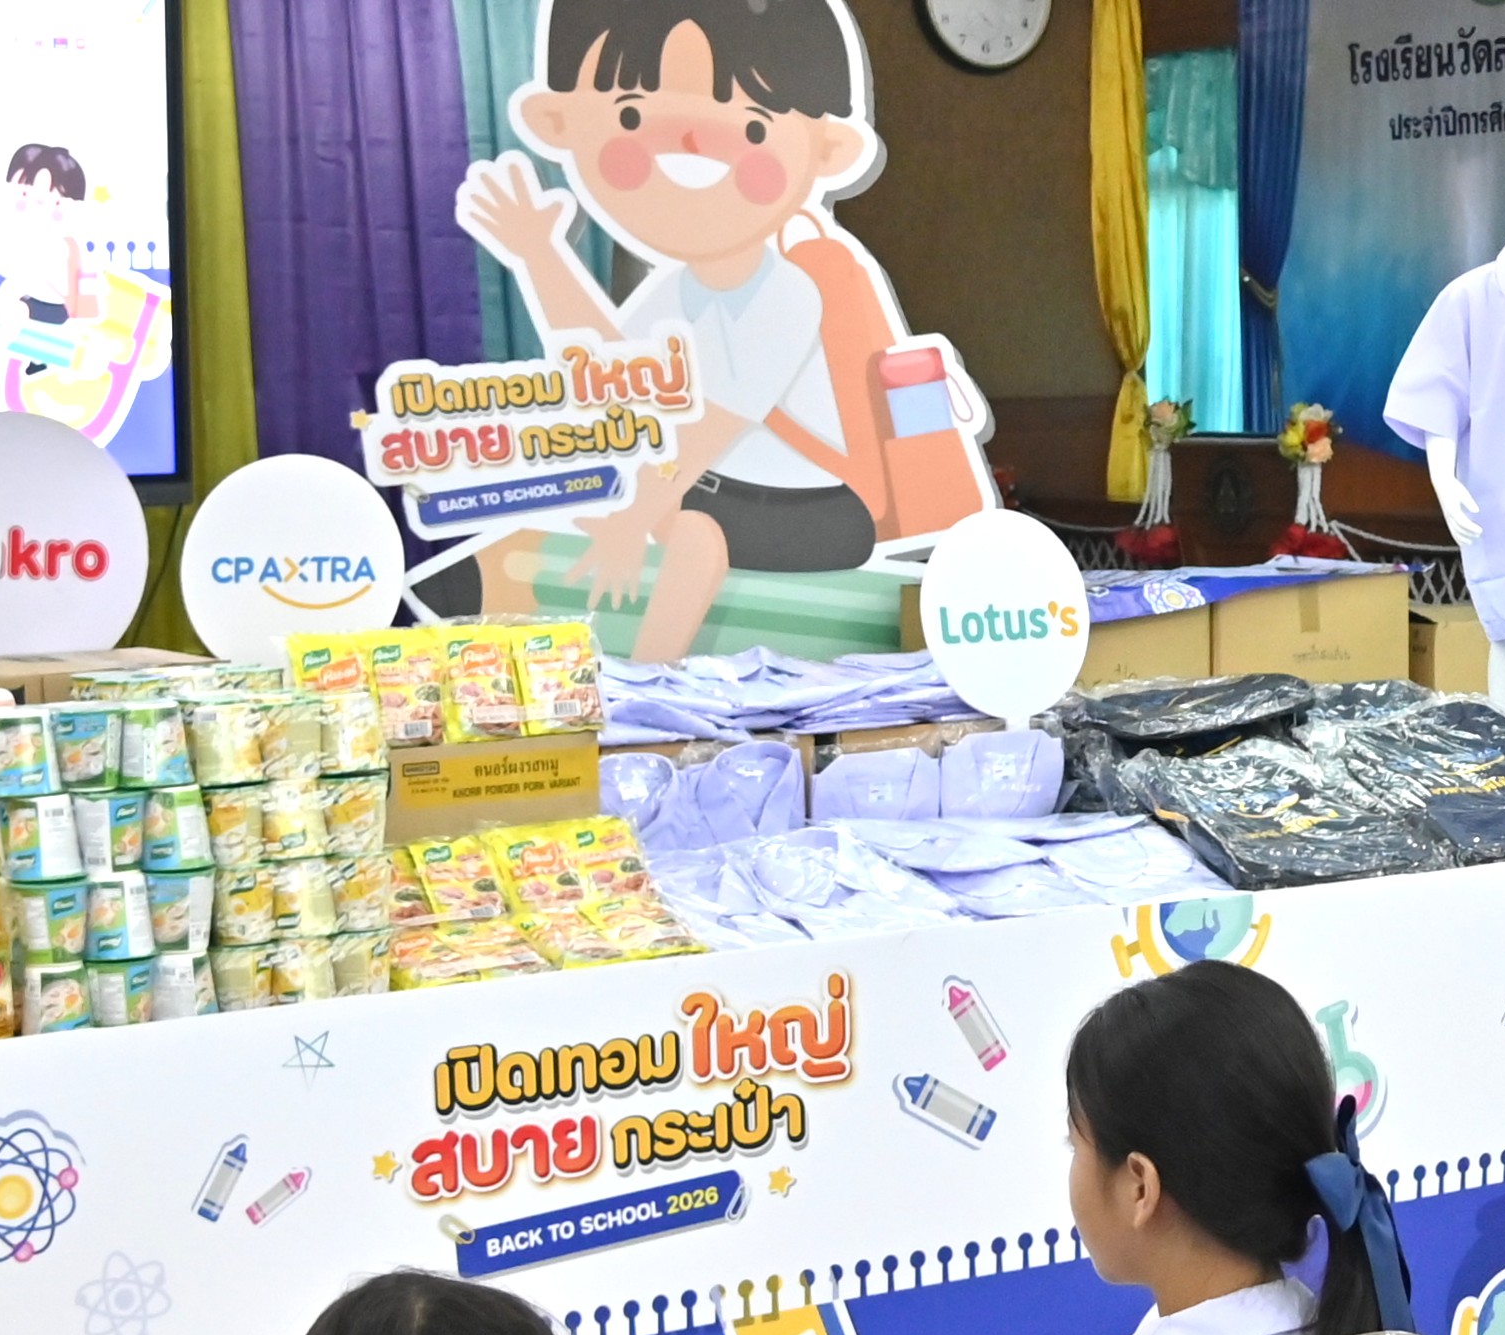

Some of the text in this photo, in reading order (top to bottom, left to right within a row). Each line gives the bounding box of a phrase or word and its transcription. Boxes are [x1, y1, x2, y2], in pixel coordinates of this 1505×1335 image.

[391, 336, 689, 417] เปิดเทอม ใหญ่
[381, 404, 662, 470] สบาย กระเป๋า
[438, 476, 602, 514] BACK TO SCHOOL 2026
[0, 524, 110, 581] kro
[211, 555, 376, 583] CP AXTRA
[939, 600, 1079, 645] Lotus's
[485, 783, 520, 796] POWDER
[523, 781, 545, 792] PORK
[549, 777, 581, 789] VARIANT
[435, 973, 850, 1115] เปิดเทอม ใหญ่
[411, 1078, 805, 1196] สบาย กระเป๋า
[486, 1186, 719, 1257] BACK TO SCHOOL 2026
